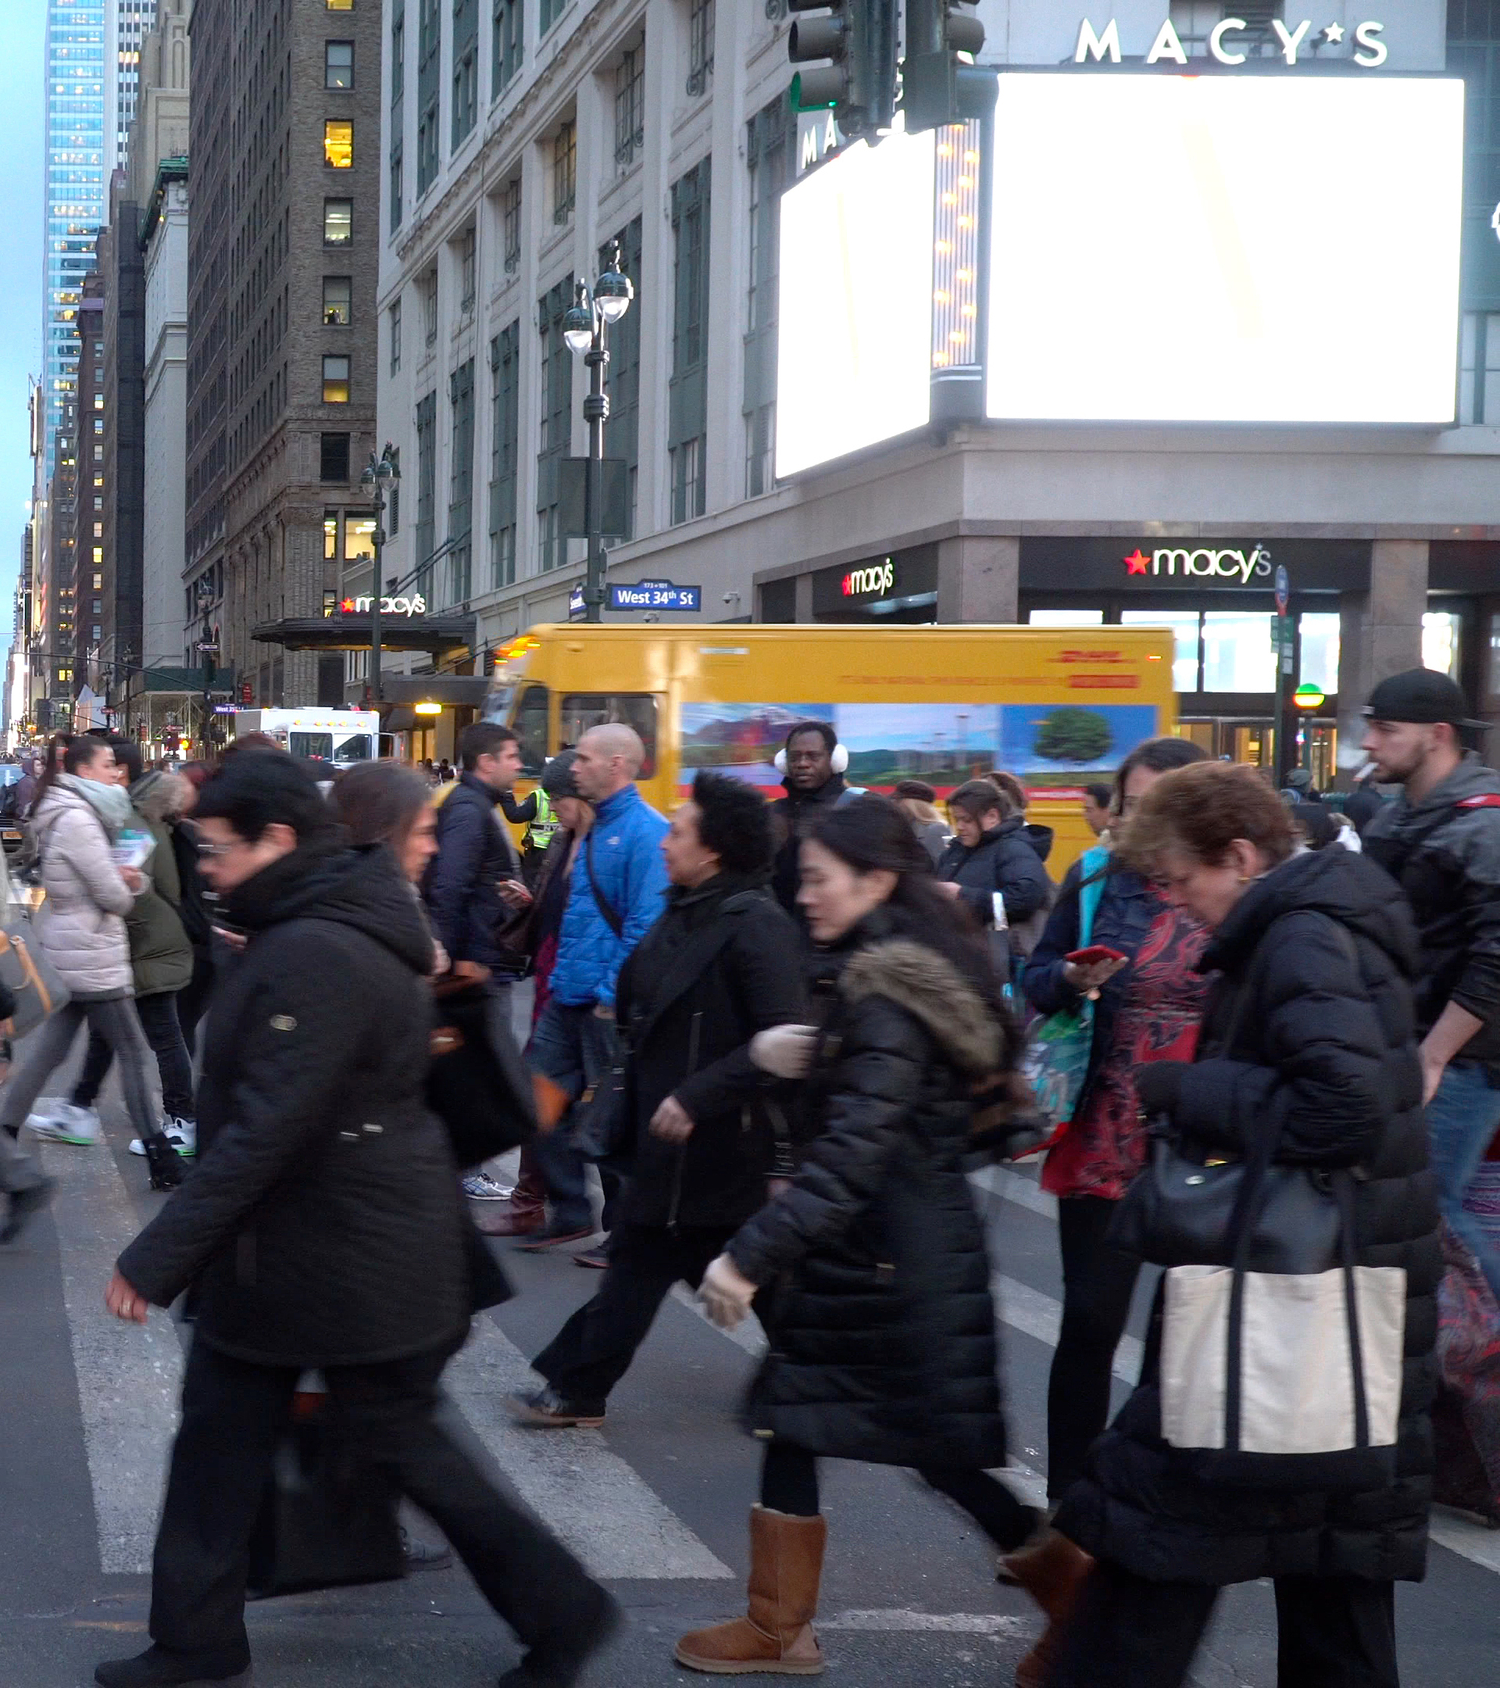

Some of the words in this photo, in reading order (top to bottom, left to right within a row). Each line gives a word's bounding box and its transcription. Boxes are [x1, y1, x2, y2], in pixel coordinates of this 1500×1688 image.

[851, 558, 894, 596] macy's
[1153, 543, 1272, 584] macy's
[618, 590, 650, 604] West
[653, 590, 677, 605] 34th
[679, 592, 694, 606] St
